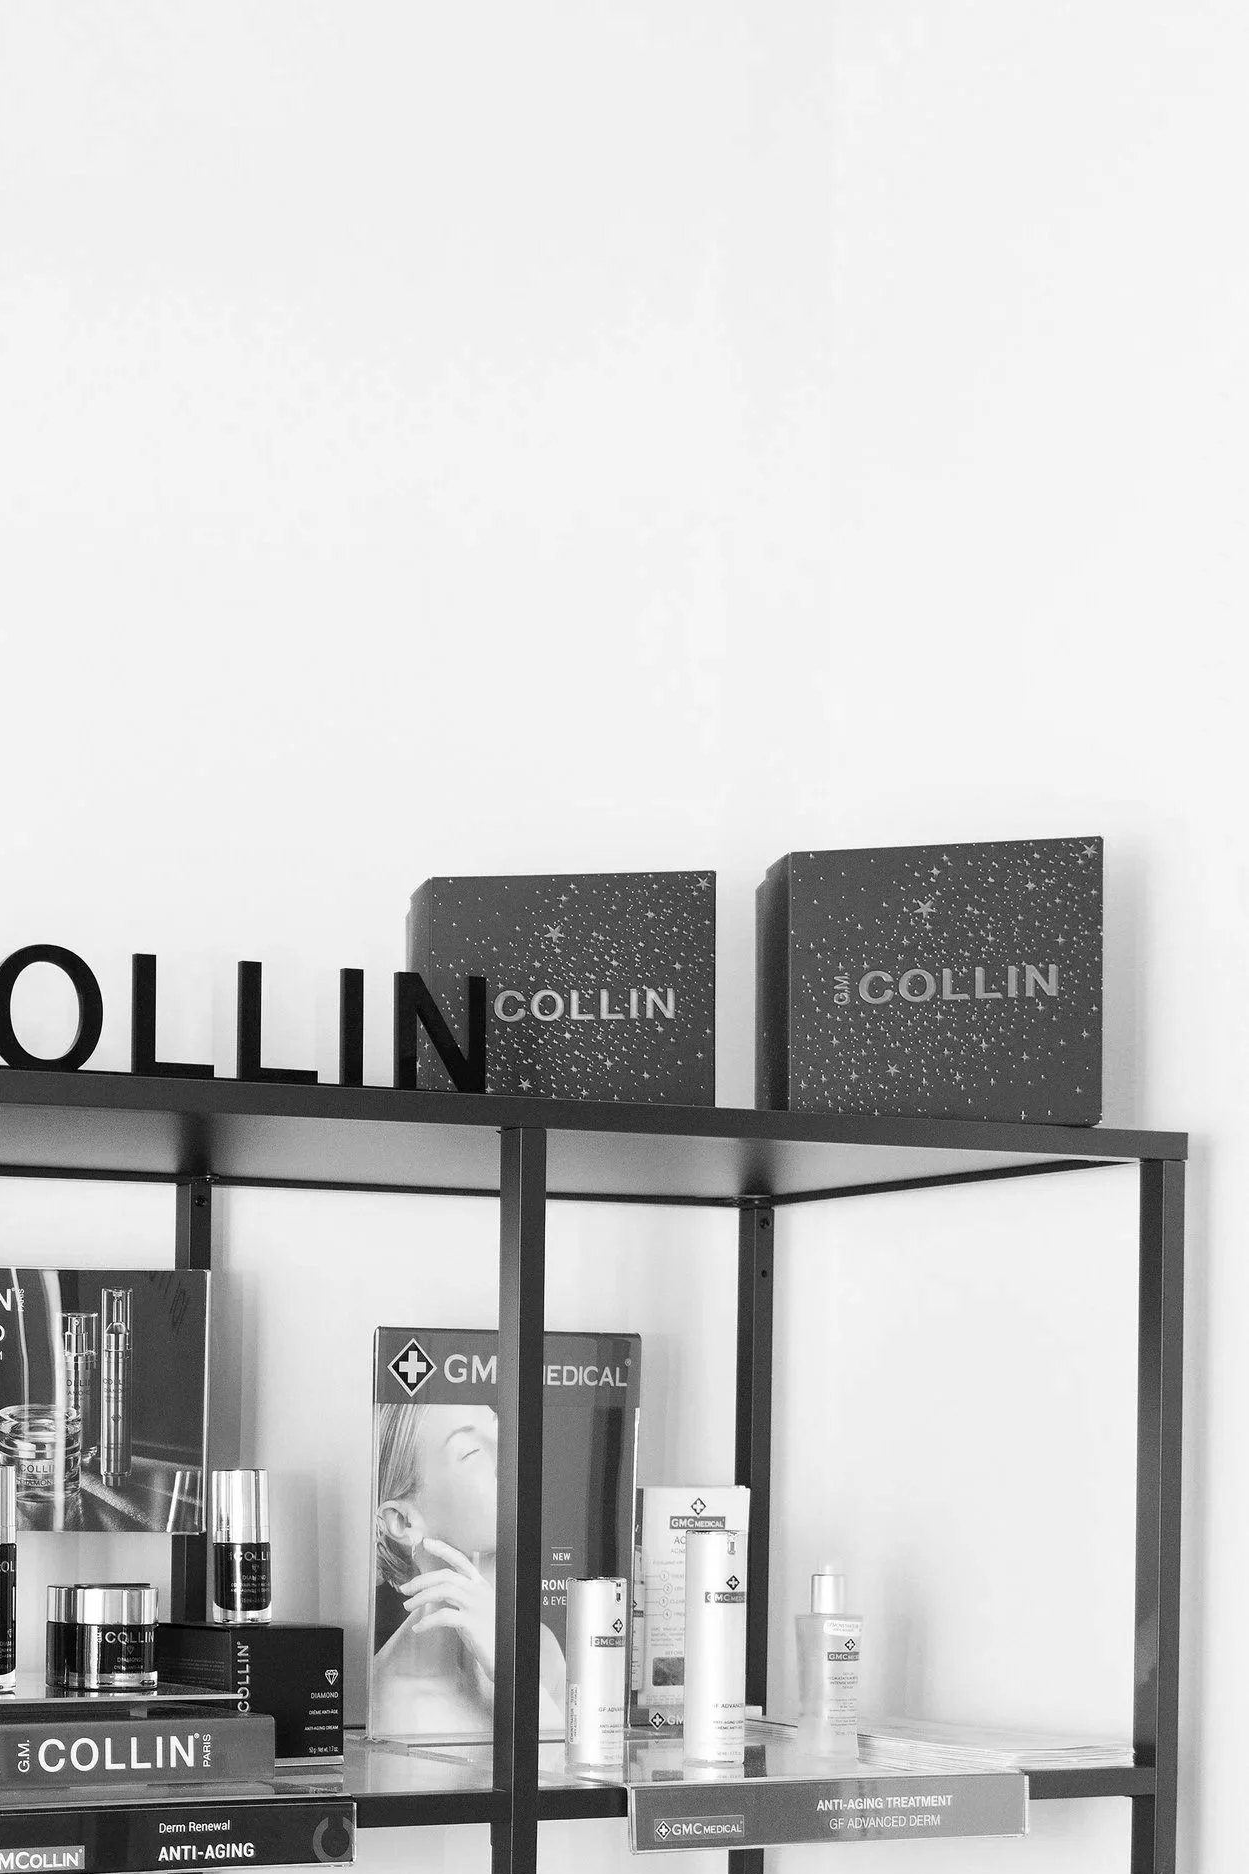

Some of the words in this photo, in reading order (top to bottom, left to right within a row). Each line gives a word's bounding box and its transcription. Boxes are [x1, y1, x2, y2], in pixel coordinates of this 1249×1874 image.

[859, 964, 1058, 1005] COLLIN
[493, 989, 675, 1022] COLLIN
[552, 1552, 571, 1561] NEW
[105, 1632, 153, 1644] COLLIN
[238, 1645, 249, 1712] COLLIN
[38, 1736, 194, 1772] COLLIN
[203, 1734, 211, 1767] PARIS
[817, 1797, 883, 1811] ANTI-AGING
[886, 1795, 952, 1809] TREATMENT
[159, 1821, 186, 1833] Derm
[189, 1820, 230, 1832] Renewal
[829, 1818, 844, 1829] GF
[847, 1816, 906, 1829] ADVANCED
[909, 1815, 940, 1827] DERM
[159, 1843, 254, 1861] ANTI-AGING
